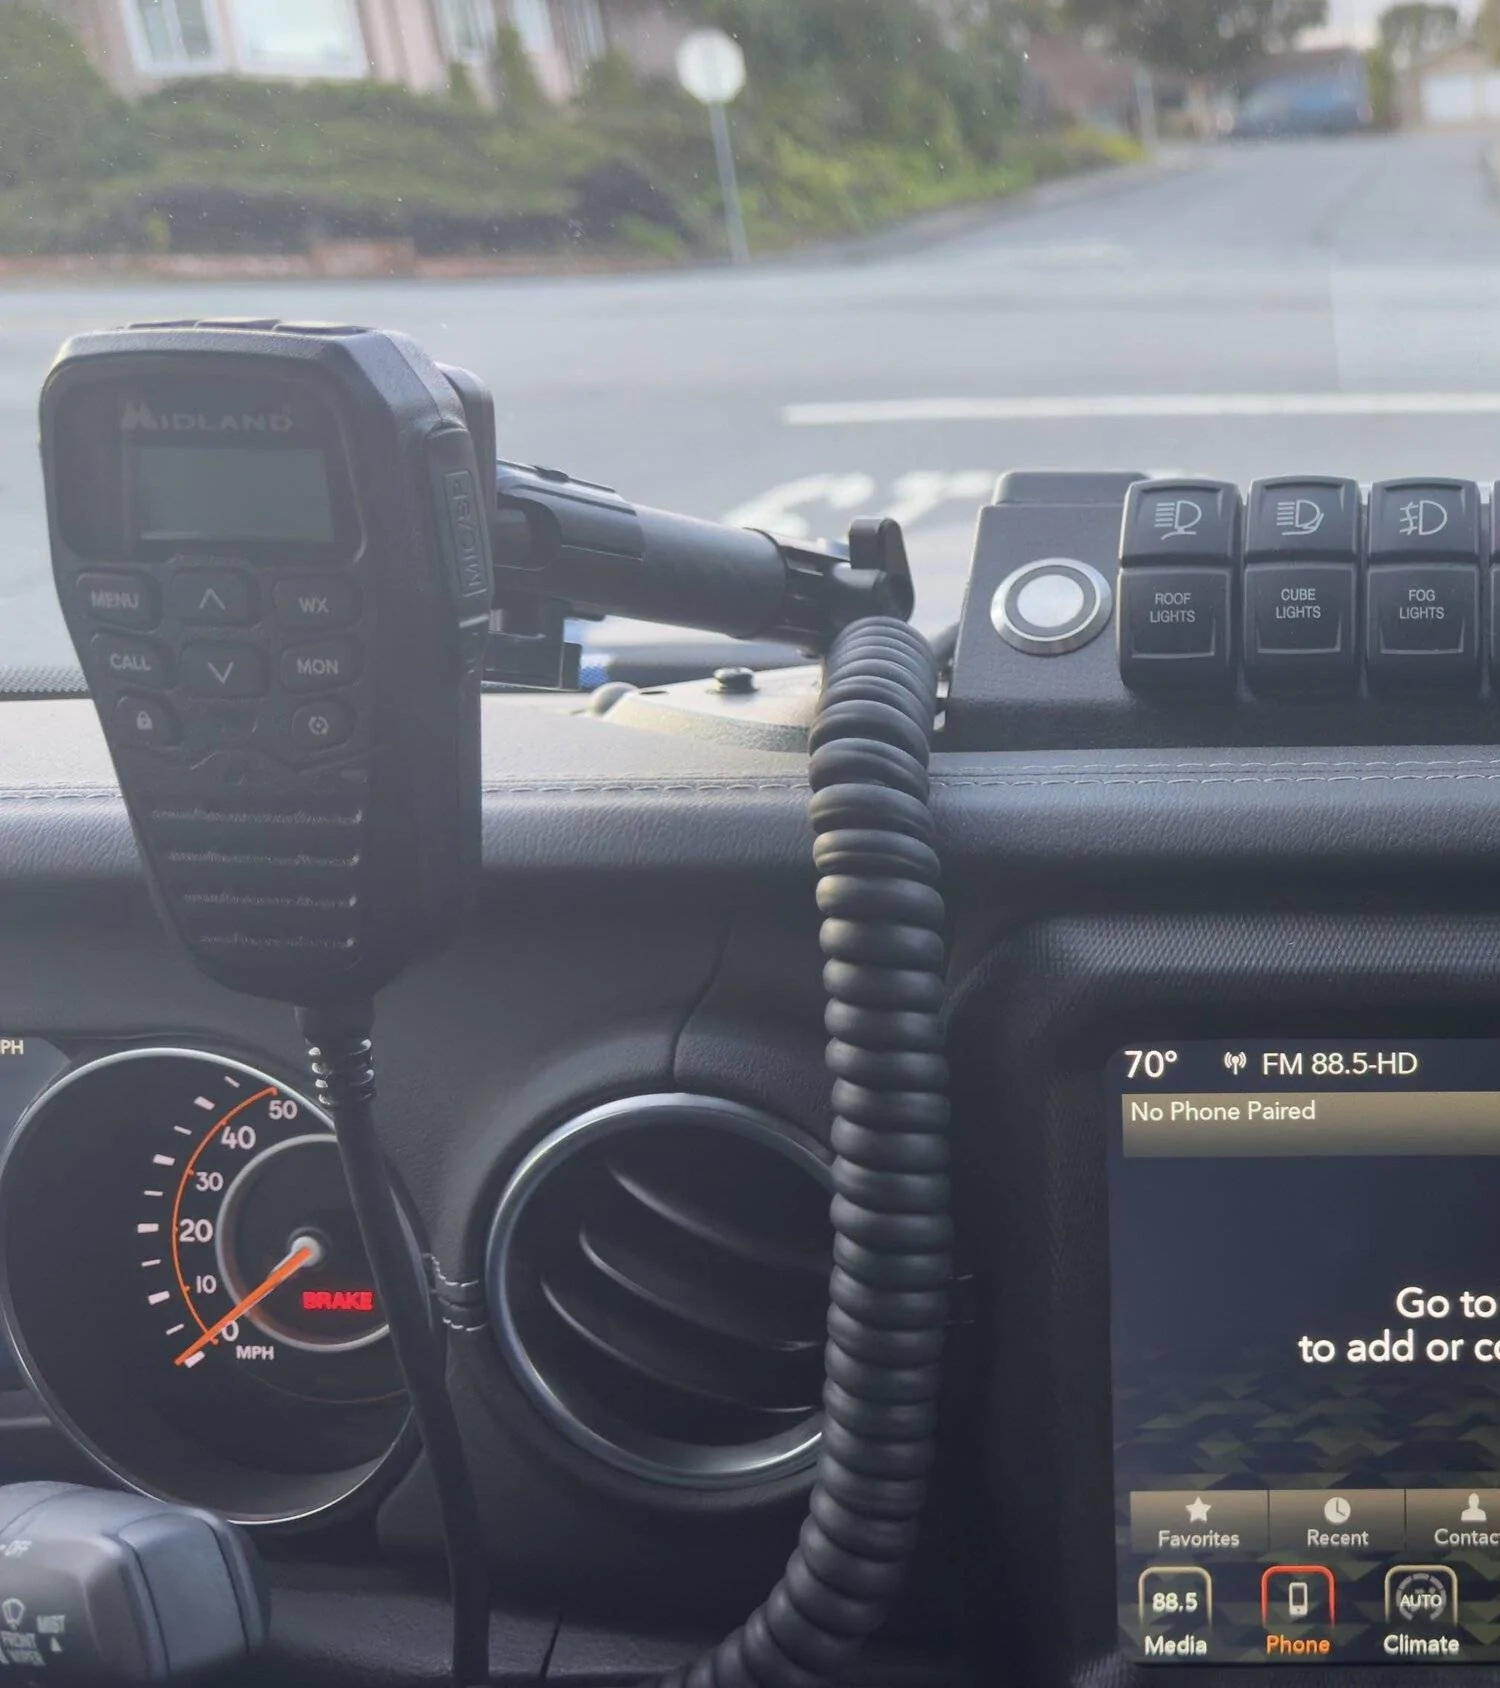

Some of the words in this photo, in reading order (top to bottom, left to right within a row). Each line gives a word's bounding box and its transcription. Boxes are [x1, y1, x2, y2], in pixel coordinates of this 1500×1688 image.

[119, 399, 294, 431] MIDLAND
[91, 590, 139, 608] MENU
[1155, 592, 1191, 606] ROOF
[1280, 587, 1316, 602] CUBE
[1408, 588, 1436, 602] FOG
[299, 596, 329, 614] WX
[1275, 605, 1321, 620] LIGHTS
[1399, 605, 1445, 620] LIGHTS
[1149, 609, 1195, 623] LIGHTS
[110, 653, 152, 671] CALL
[296, 658, 339, 675] MON
[0, 1039, 25, 1056] PH
[1124, 1049, 1178, 1078] 70°
[1263, 1053, 1302, 1076] FM
[1311, 1052, 1419, 1076] 88.5-HD
[269, 1100, 297, 1120] 50
[1131, 1102, 1164, 1121] No
[1170, 1102, 1240, 1121] Phone
[1248, 1100, 1316, 1120] Paired
[221, 1125, 256, 1149] 40
[196, 1171, 224, 1191] 30
[179, 1218, 213, 1242] 20
[196, 1275, 217, 1294] 10
[303, 1291, 373, 1311] BRAKE
[1396, 1287, 1450, 1318] Go
[1460, 1290, 1497, 1318] to
[221, 1320, 239, 1341] 0
[236, 1345, 275, 1360] MPH
[1298, 1332, 1336, 1363] to
[1347, 1328, 1414, 1363] add
[1426, 1338, 1464, 1362] or
[1158, 1530, 1240, 1548] Favorites
[1307, 1529, 1369, 1547] Recent
[1152, 1592, 1198, 1612] 88.5
[1400, 1594, 1441, 1609] AUTO
[1144, 1634, 1208, 1656] Media
[1266, 1634, 1330, 1656] Phone
[1383, 1633, 1460, 1656] Climate
